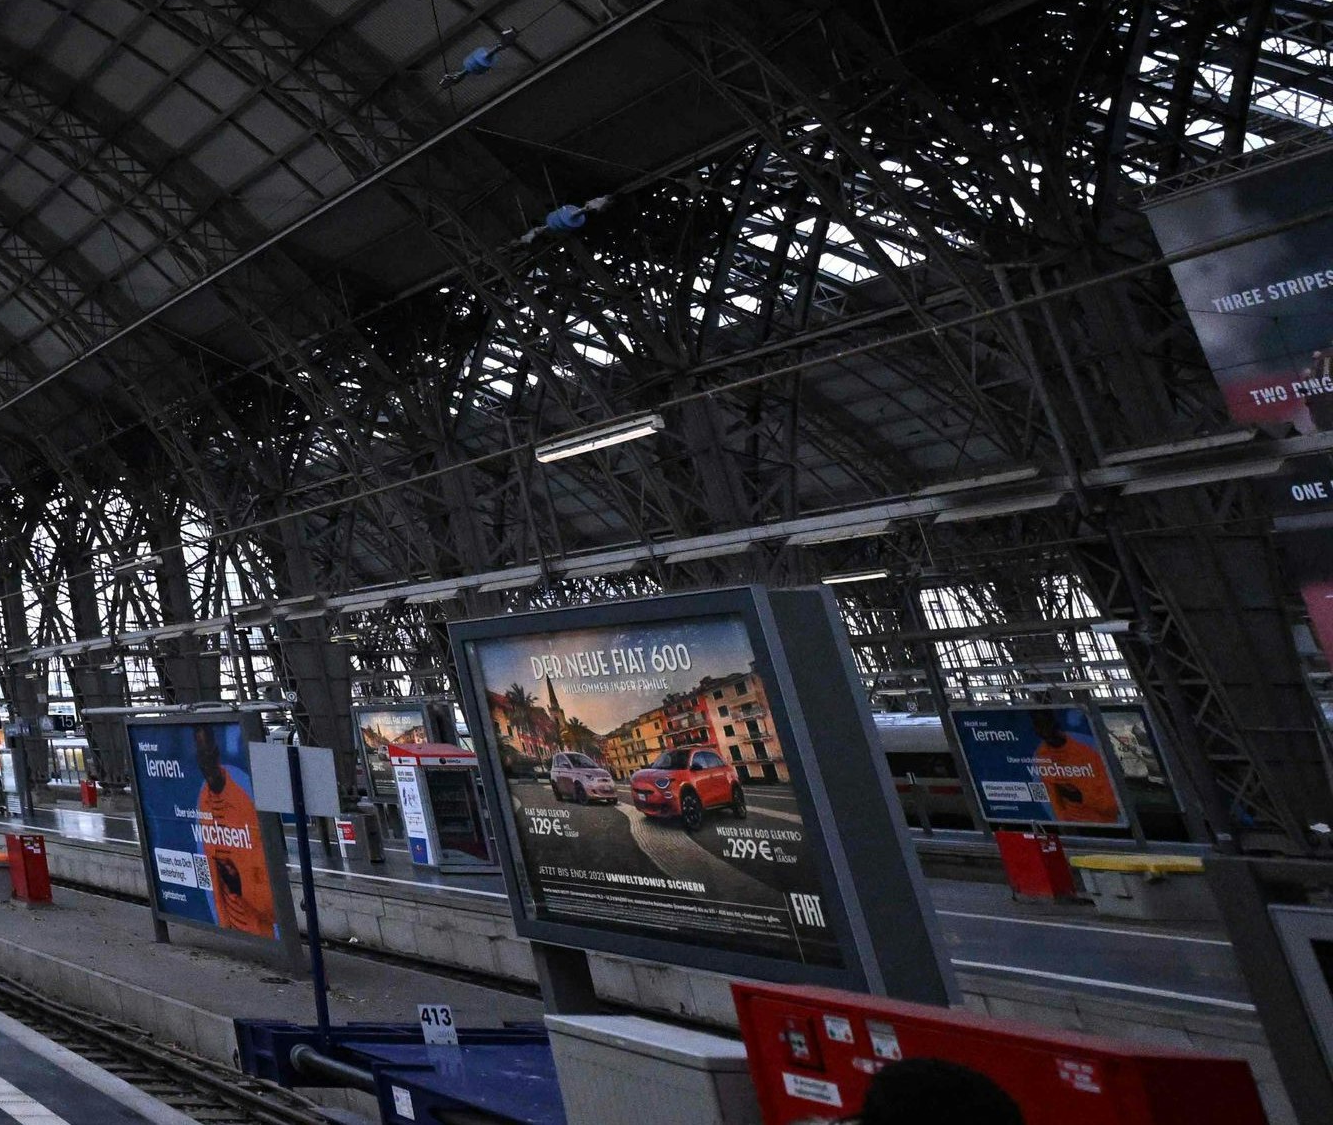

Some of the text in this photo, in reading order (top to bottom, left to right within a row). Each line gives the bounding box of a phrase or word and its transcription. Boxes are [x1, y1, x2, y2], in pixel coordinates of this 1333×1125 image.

[1212, 270, 1333, 314] THREE STRIPES
[1249, 385, 1288, 406] TWO
[1291, 482, 1328, 502] ONE
[530, 643, 692, 681] DER NEUE FIAT 600
[562, 678, 669, 694] WILLKOMMEN IN DER FAMILIE
[58, 715, 74, 728] 15
[971, 728, 1019, 742] lernen.
[144, 754, 184, 778] lernen.
[1026, 763, 1095, 778] wachsen!
[524, 808, 536, 816] FIAT
[191, 821, 252, 850] wachsen!
[716, 826, 739, 838] NEUER
[738, 828, 754, 838] FIAT
[769, 830, 803, 842] ELEKTRO
[539, 865, 706, 893] JETZT BIS ENDE 2023 UMWELTBONUS SICHERN
[790, 893, 826, 928] FIAT
[421, 1007, 452, 1026] 413
